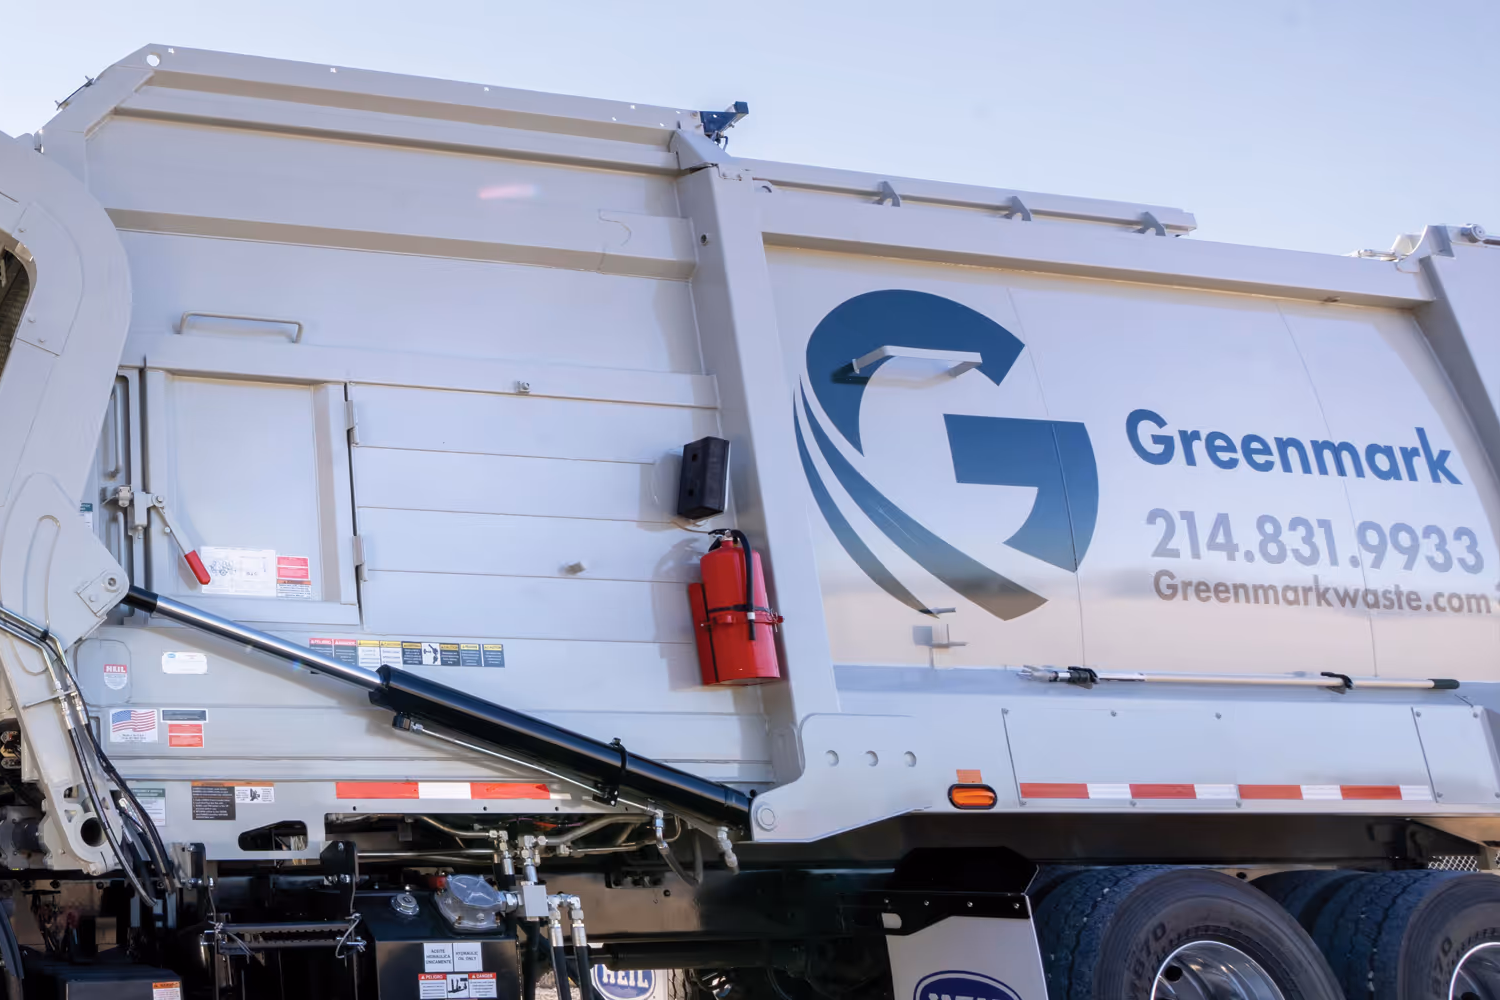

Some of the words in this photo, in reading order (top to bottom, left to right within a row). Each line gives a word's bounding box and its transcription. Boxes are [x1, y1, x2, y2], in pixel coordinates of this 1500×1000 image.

[1125, 408, 1463, 486] Greenmark
[1145, 507, 1485, 575] 214.831.9933
[1152, 569, 1493, 615] Greenmarkwaste.com
